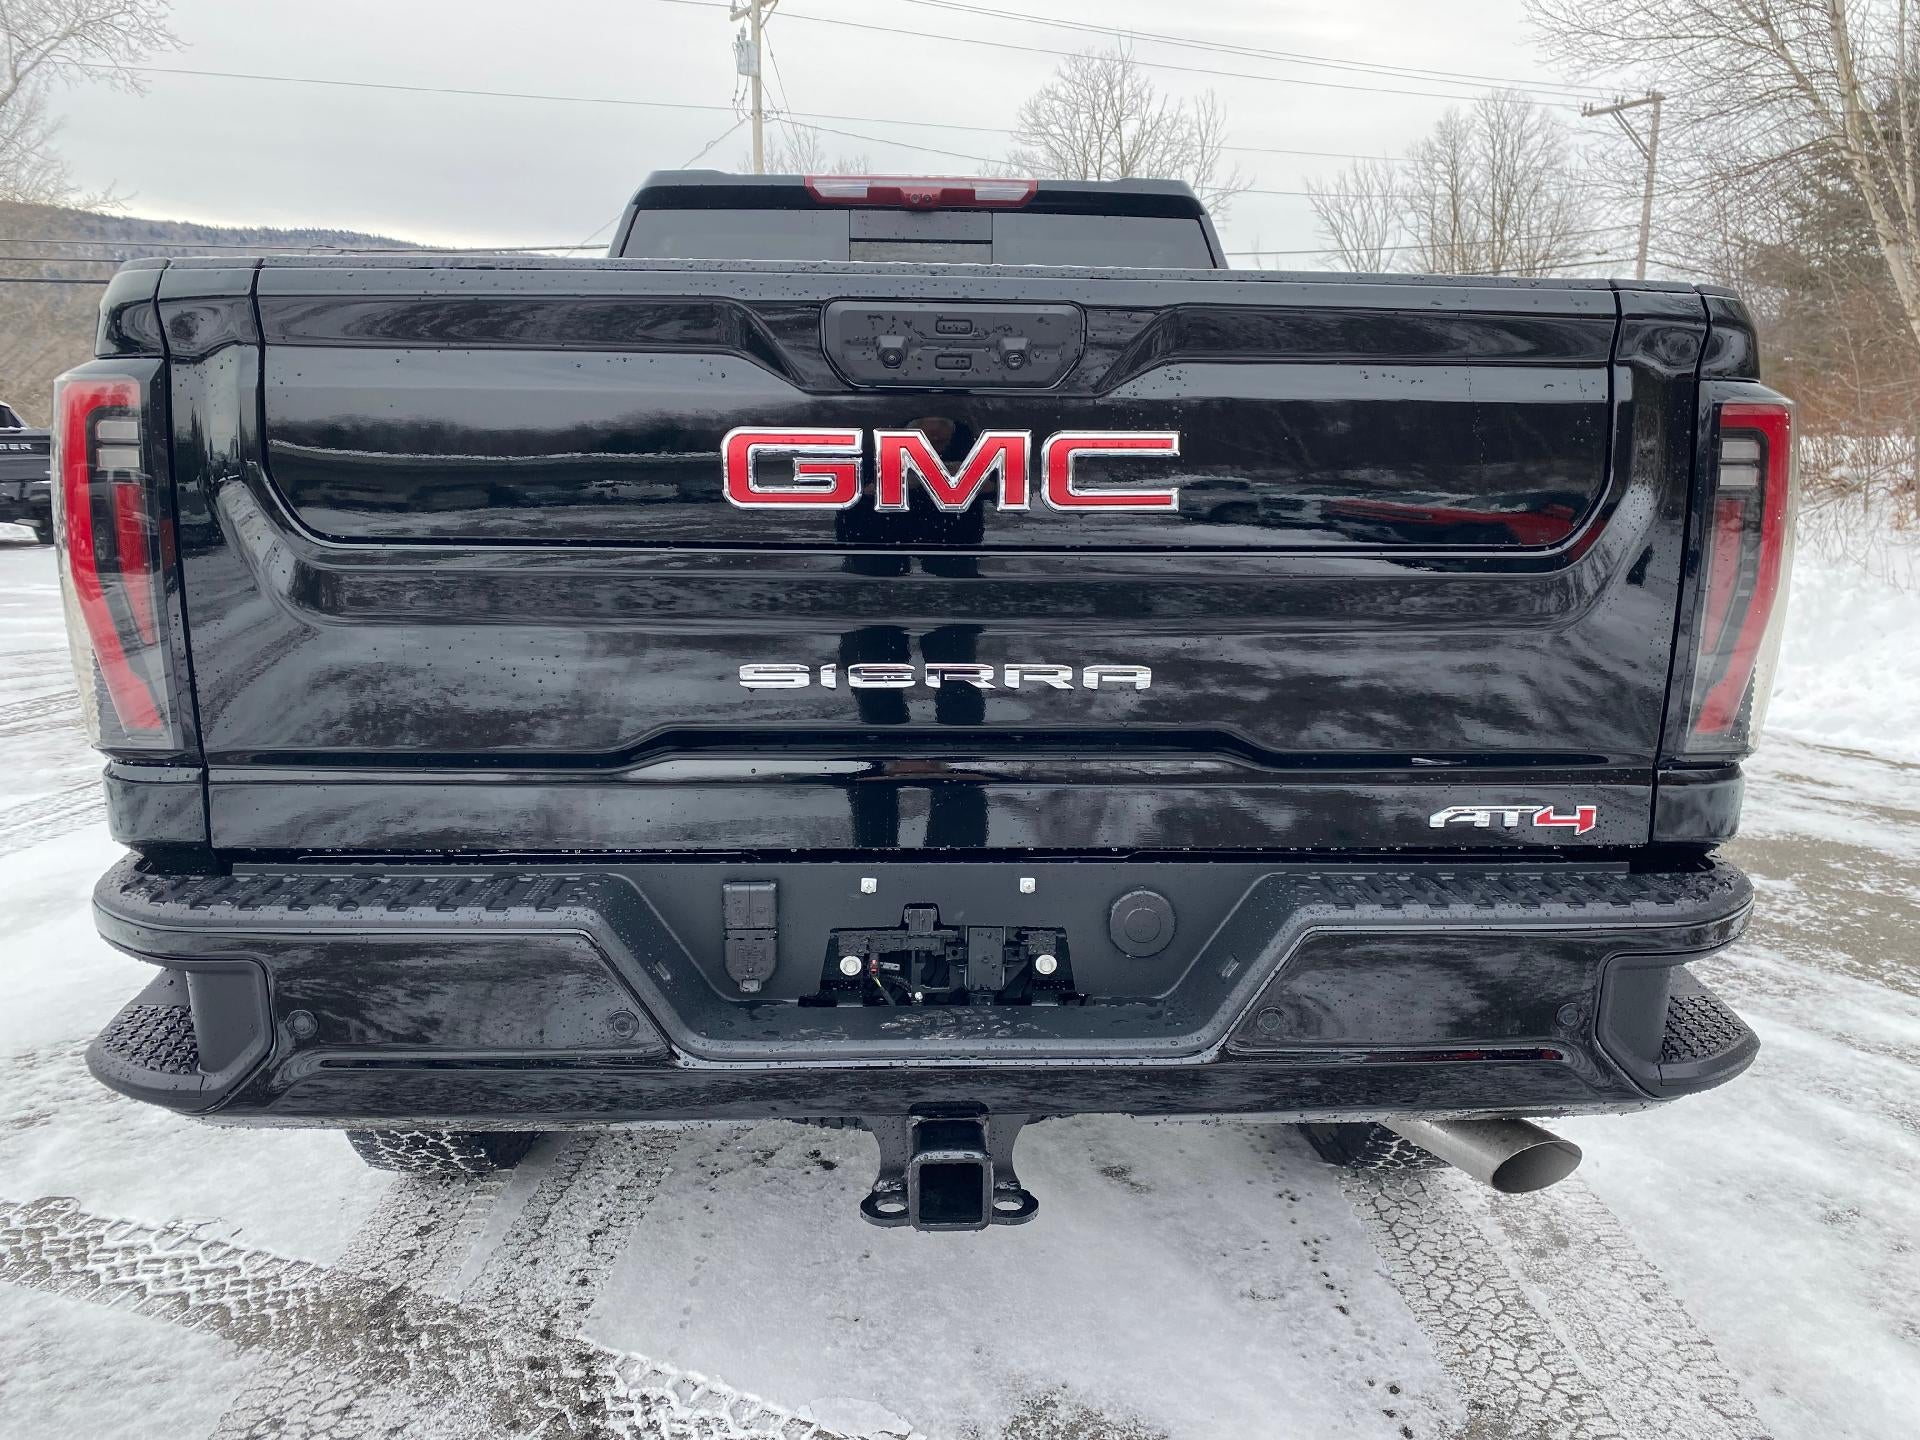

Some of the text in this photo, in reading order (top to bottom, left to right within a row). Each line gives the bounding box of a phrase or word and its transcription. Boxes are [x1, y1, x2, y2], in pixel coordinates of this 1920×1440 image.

[721, 427, 1181, 513] GMC
[739, 663, 1152, 690] SIERRA
[1429, 806, 1597, 836] AT4
